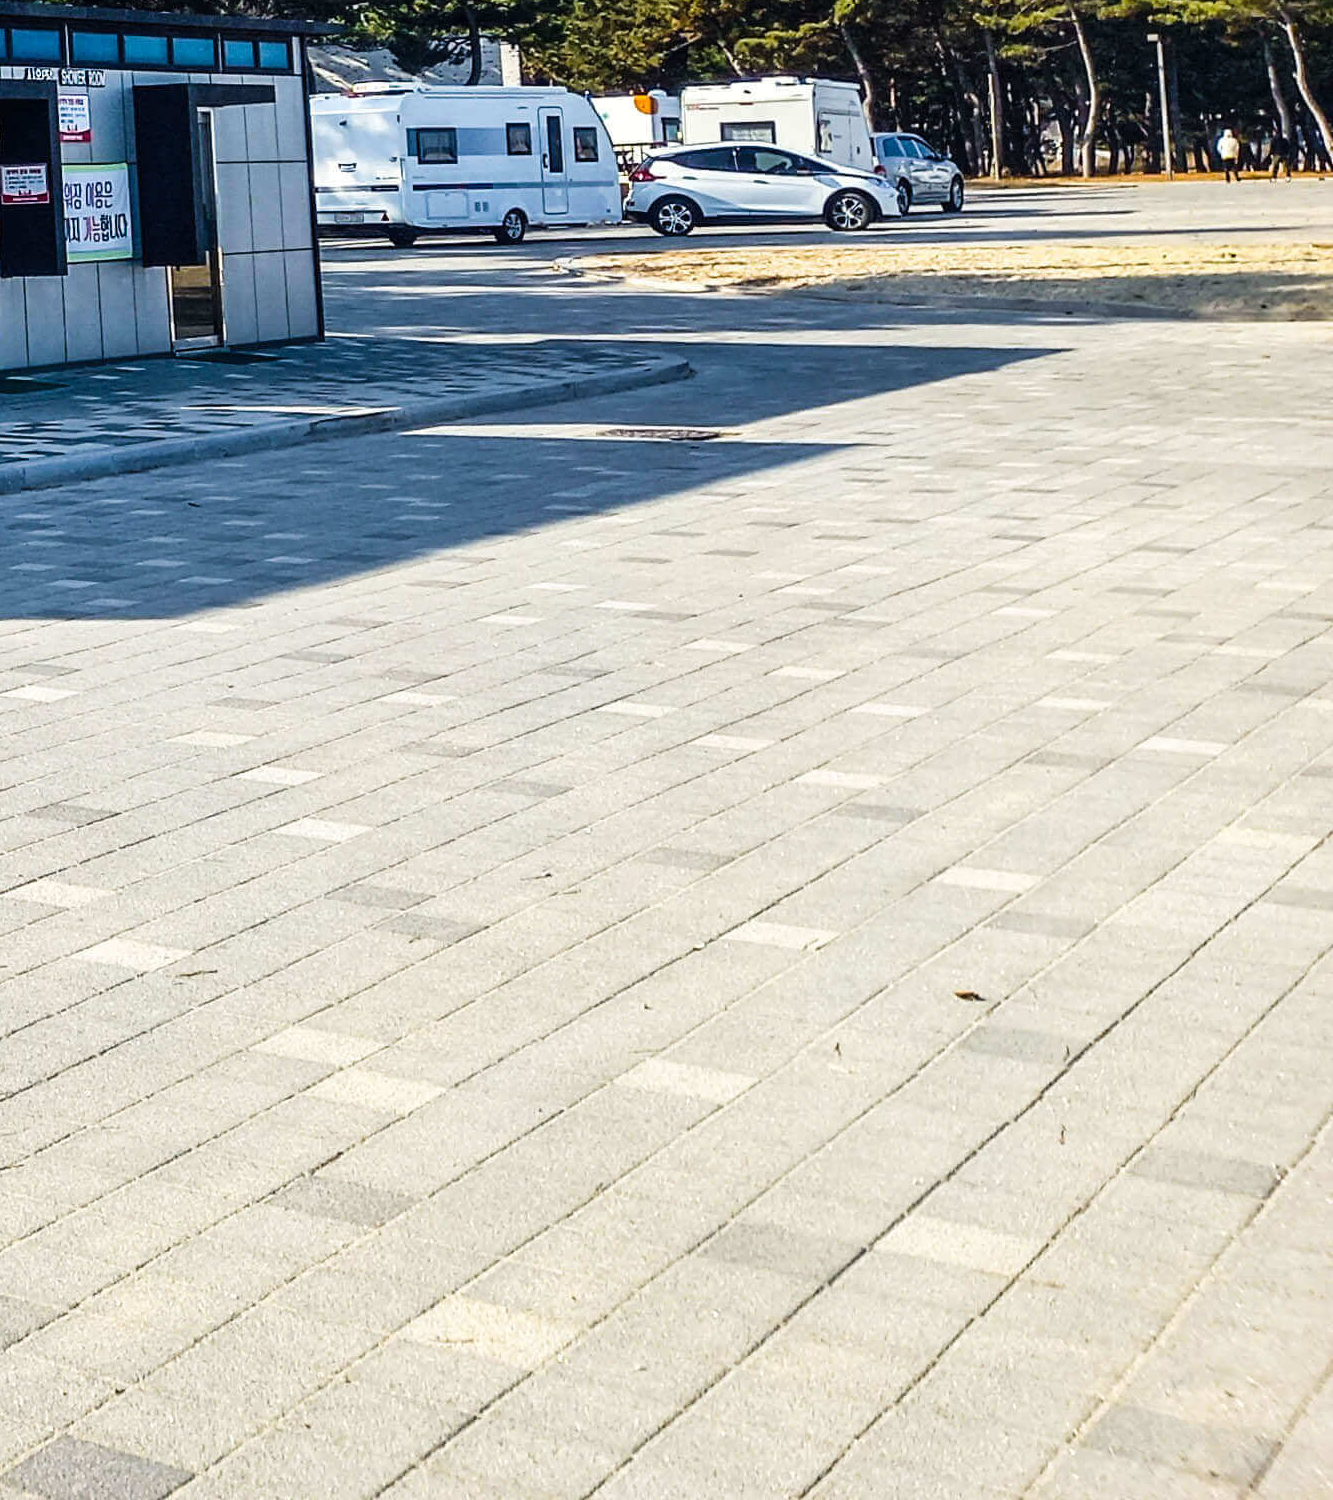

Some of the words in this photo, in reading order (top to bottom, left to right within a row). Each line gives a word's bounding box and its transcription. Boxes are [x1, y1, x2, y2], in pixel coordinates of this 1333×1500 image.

[60, 69, 86, 85] SHOWER
[85, 180, 113, 208] 이용은
[83, 212, 128, 242] 가능합니다
